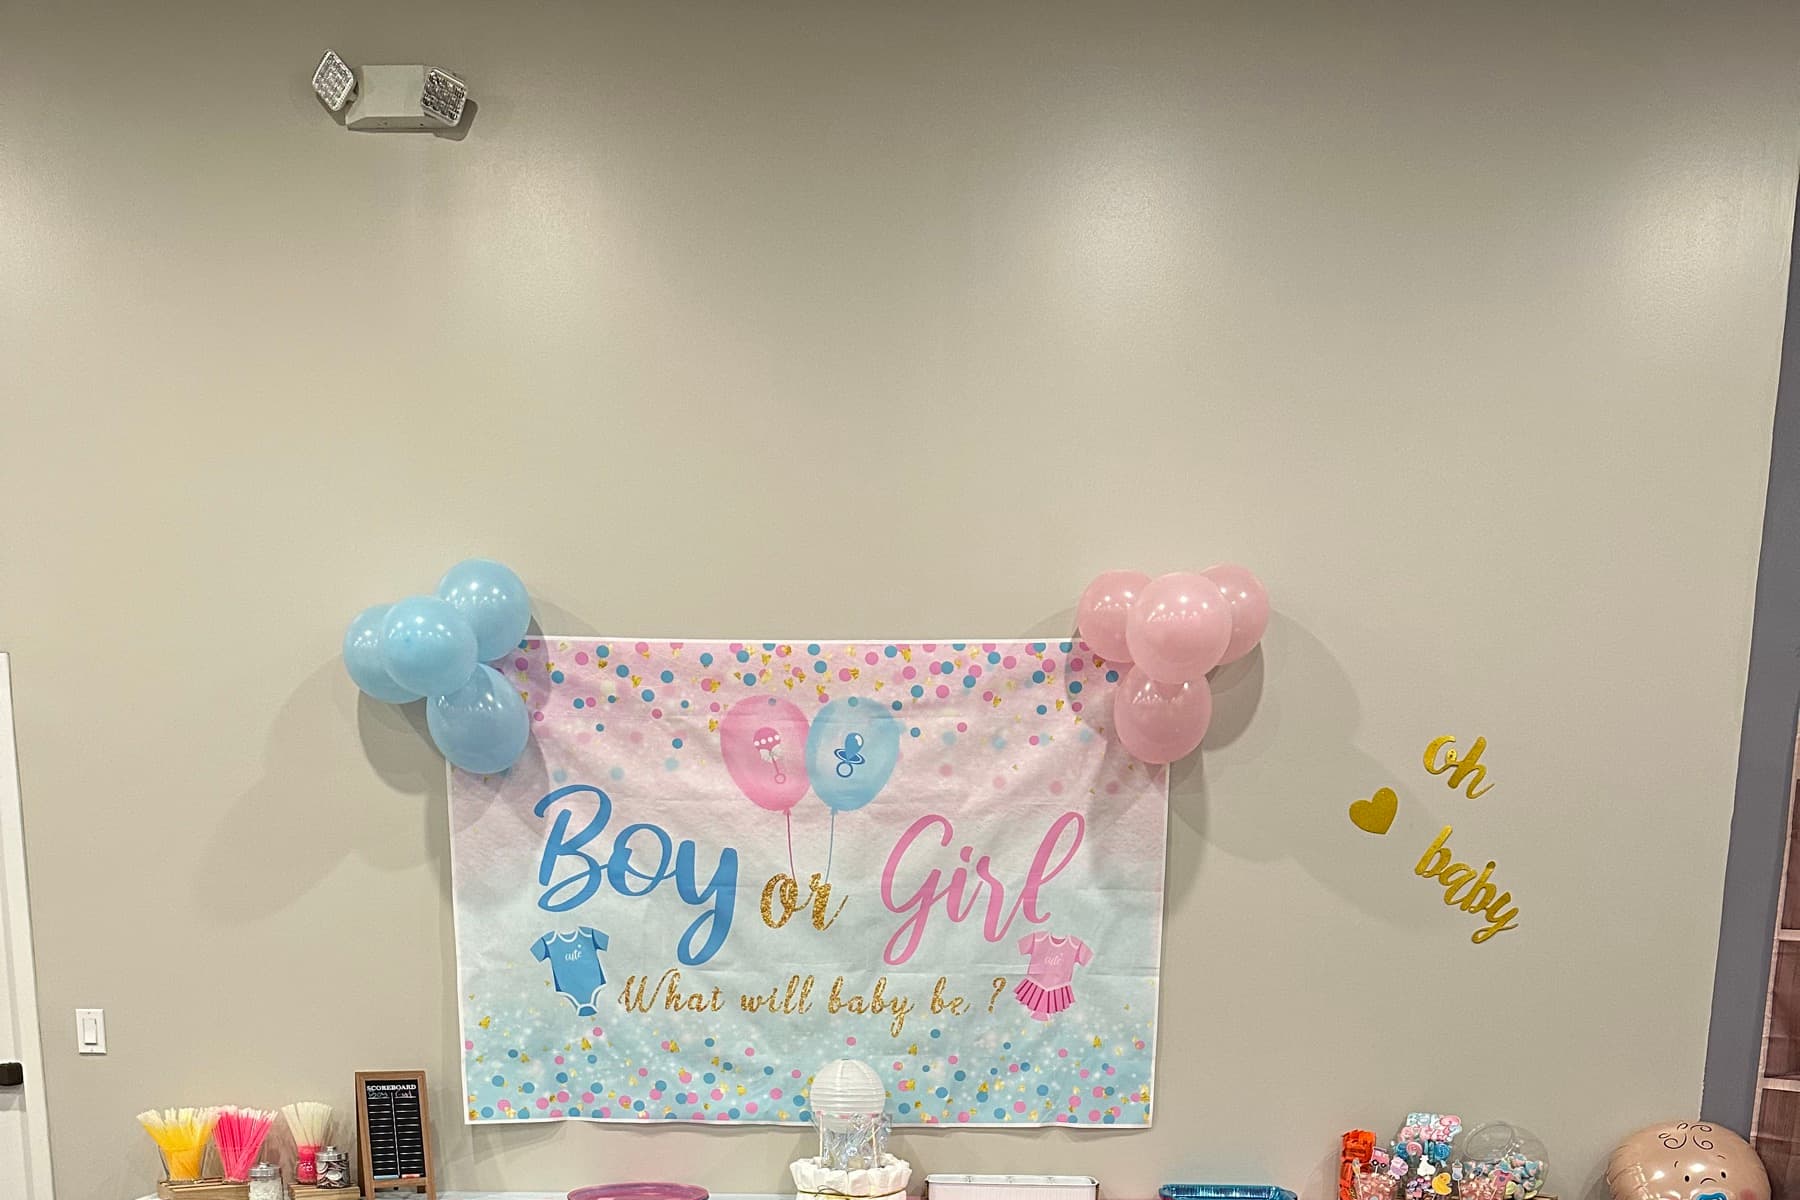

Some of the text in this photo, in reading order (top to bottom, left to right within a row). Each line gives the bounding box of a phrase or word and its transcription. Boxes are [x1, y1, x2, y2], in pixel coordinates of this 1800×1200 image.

[534, 784, 1085, 966] Boy or Girl
[1415, 825, 1519, 944] baby
[617, 968, 725, 1014] What
[740, 975, 814, 1014] will
[828, 976, 915, 1037] baby
[930, 976, 971, 1016] be
